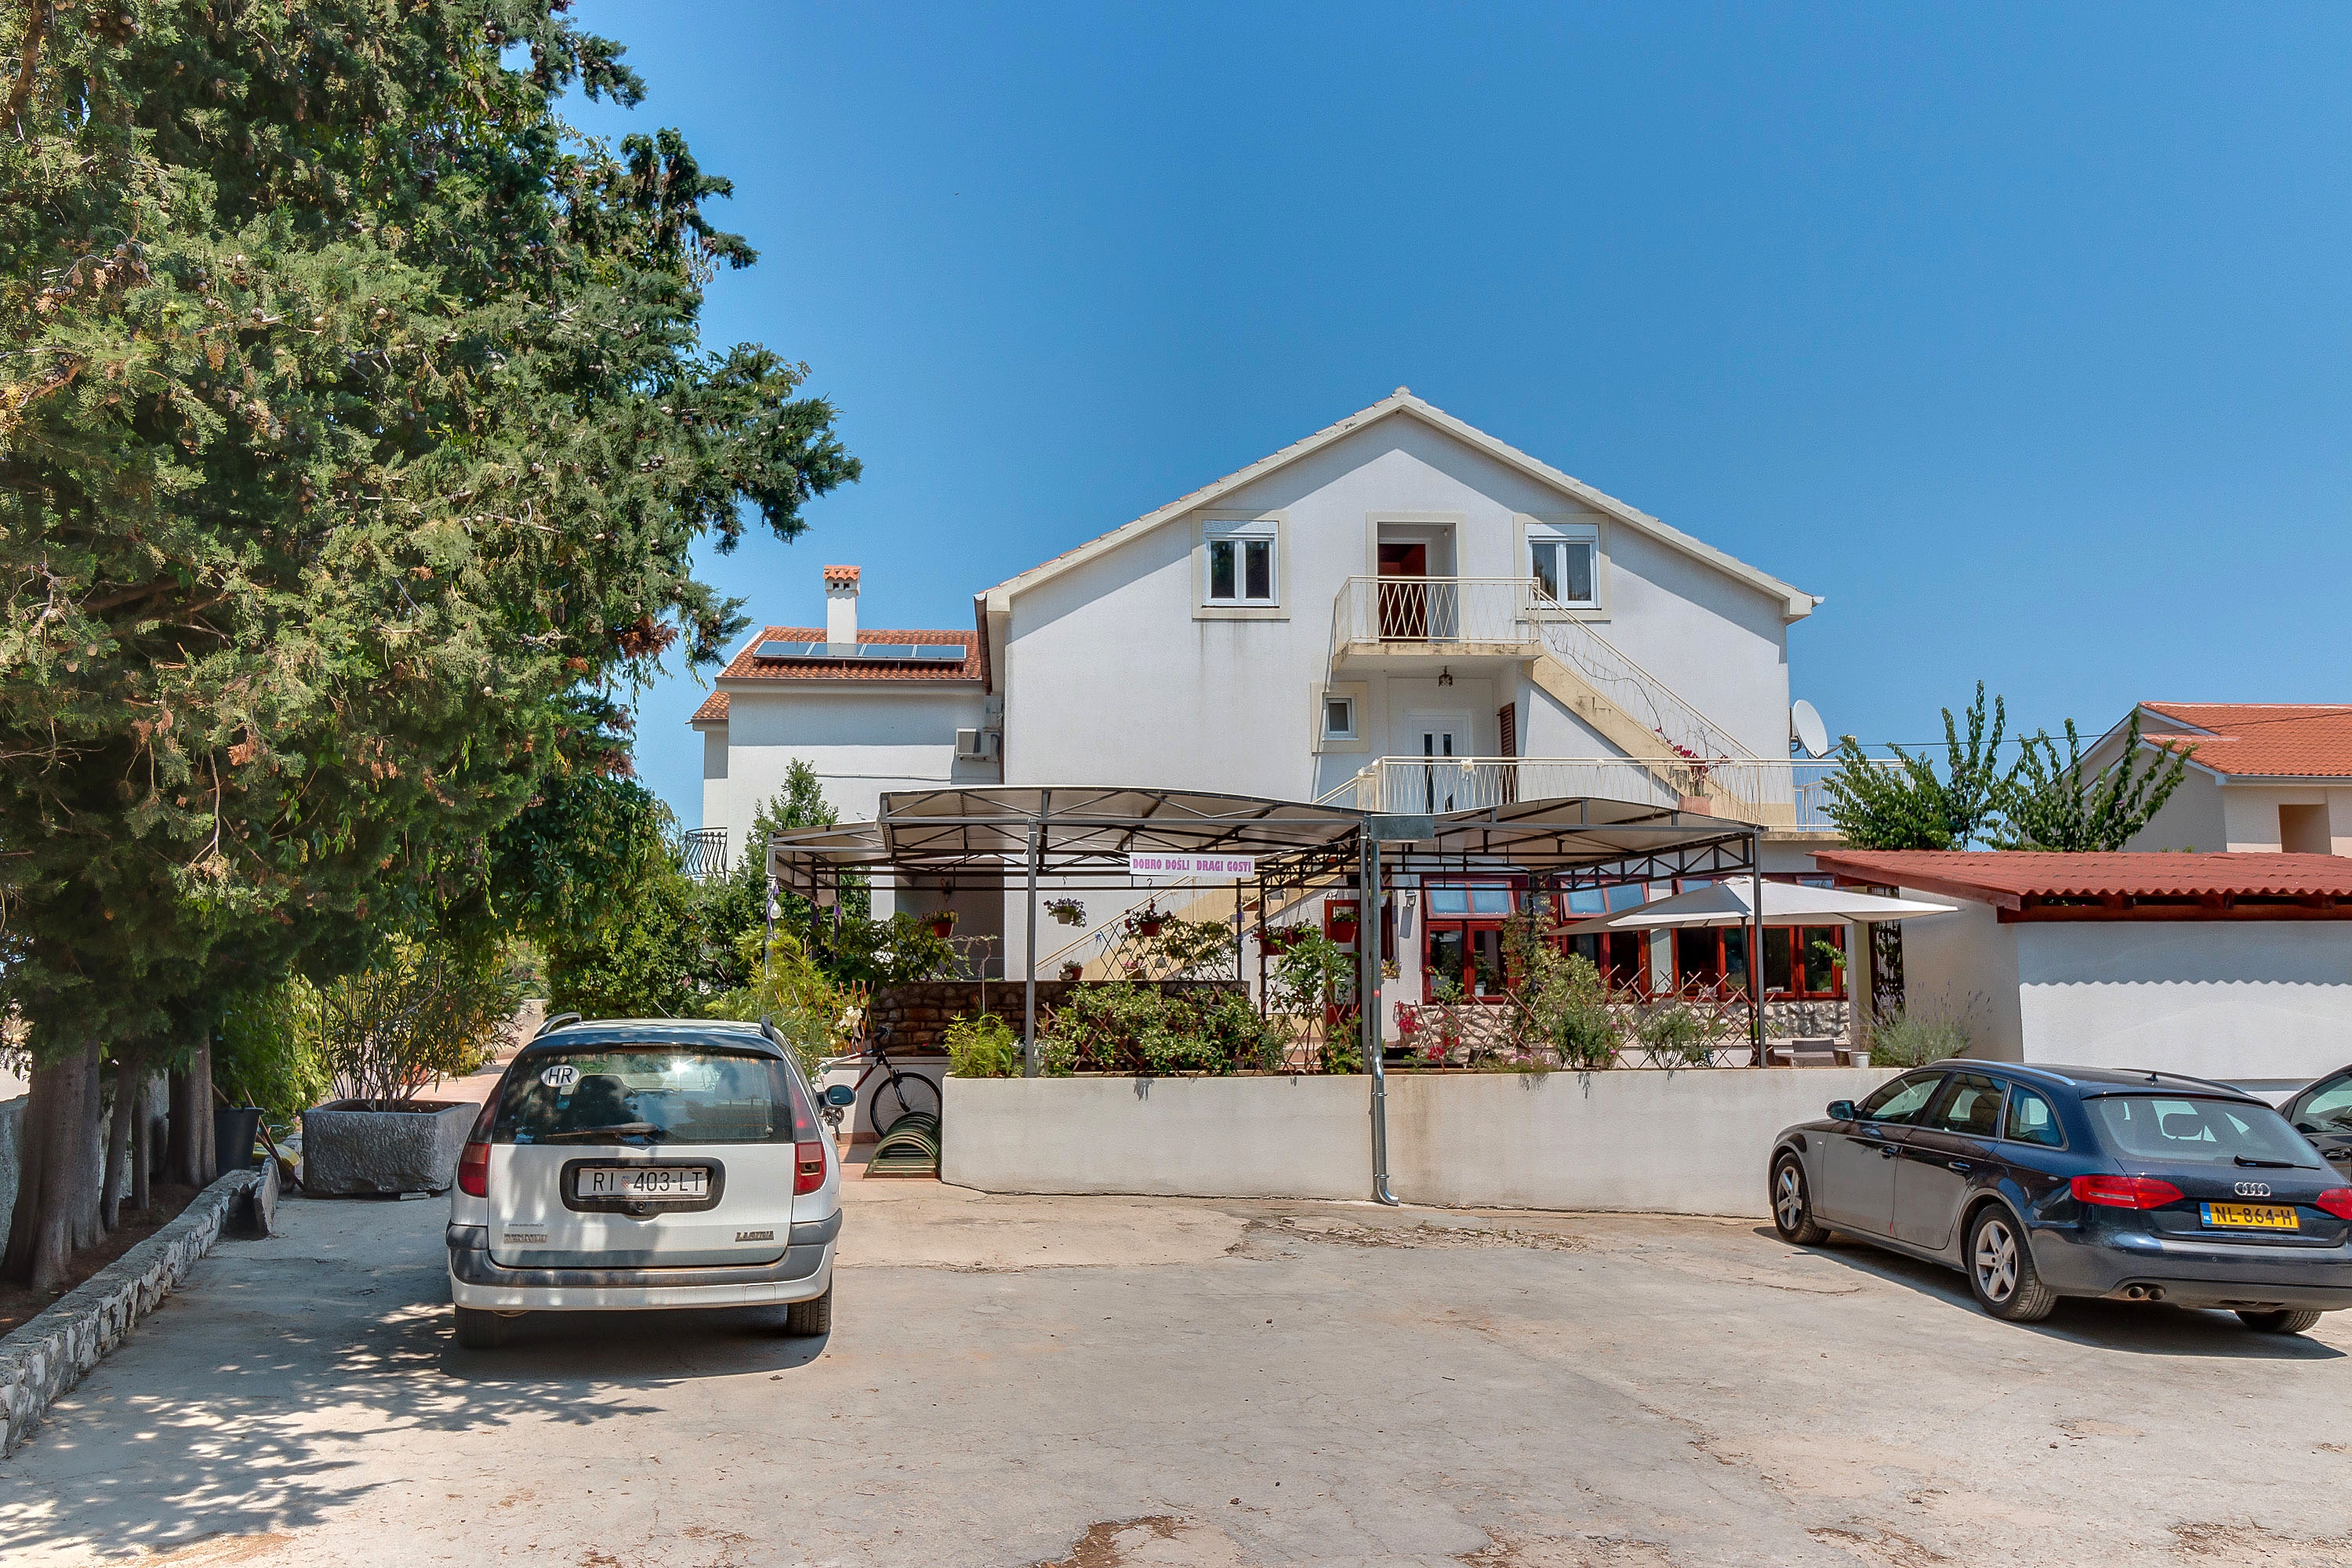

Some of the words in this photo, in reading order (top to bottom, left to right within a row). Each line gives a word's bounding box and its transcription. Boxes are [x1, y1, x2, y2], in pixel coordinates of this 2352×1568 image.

[1132, 858, 1162, 869] DOBRO
[1165, 857, 1189, 870] DOŠLI
[1196, 859, 1224, 872] DRAGI
[1227, 861, 1251, 873] GOSTI
[548, 1067, 573, 1084] HR
[593, 1172, 615, 1192] RI
[633, 1171, 702, 1192] 403-LT
[2215, 1206, 2292, 1225] NL-864-H
